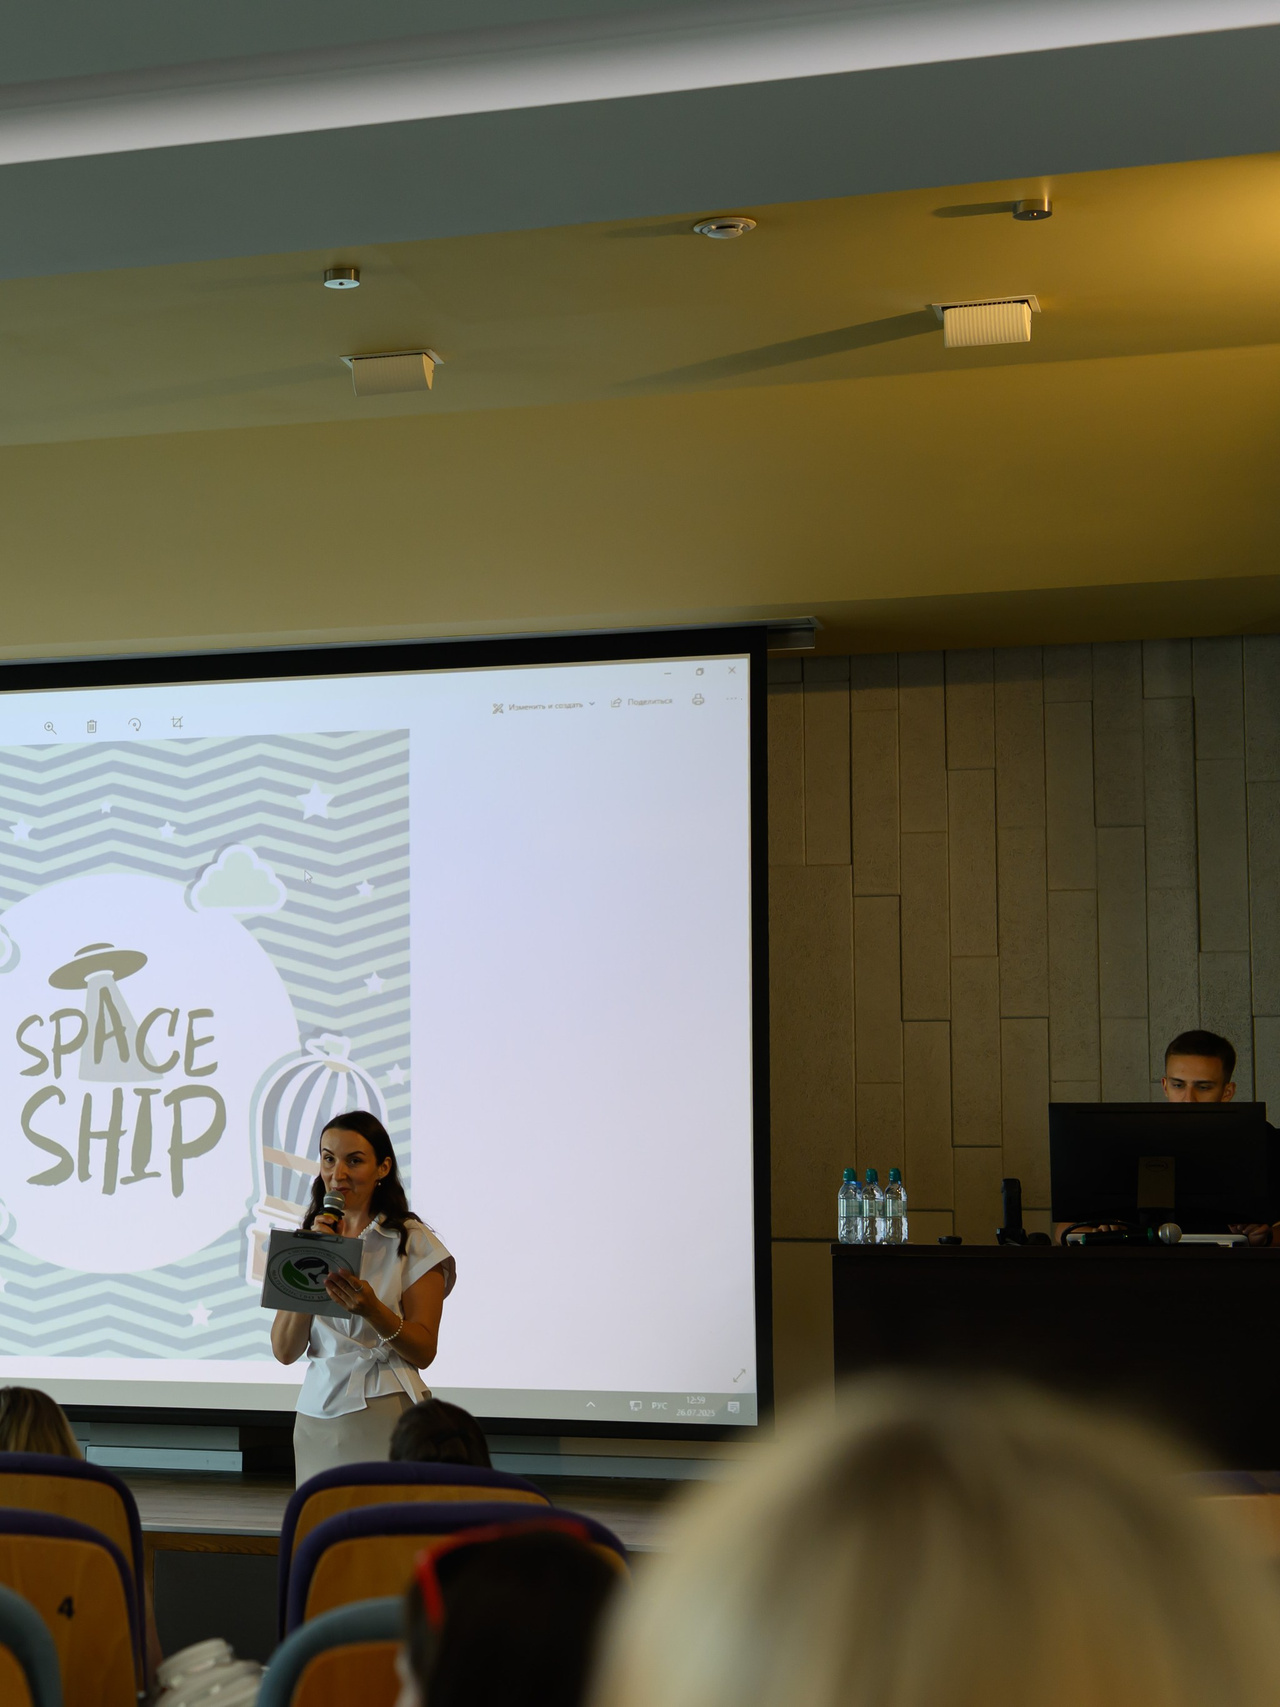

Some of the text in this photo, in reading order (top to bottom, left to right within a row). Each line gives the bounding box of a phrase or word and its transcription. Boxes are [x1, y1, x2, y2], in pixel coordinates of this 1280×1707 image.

[508, 703, 546, 711] Изменить
[554, 702, 584, 710] создать
[627, 698, 673, 707] Поделиться
[16, 986, 218, 1079] SPACE
[20, 1084, 227, 1198] SHIP
[686, 1395, 706, 1405] 12:59
[651, 1401, 668, 1410] РУС
[676, 1408, 716, 1417] 26.07.2025
[56, 1595, 75, 1620] 4
